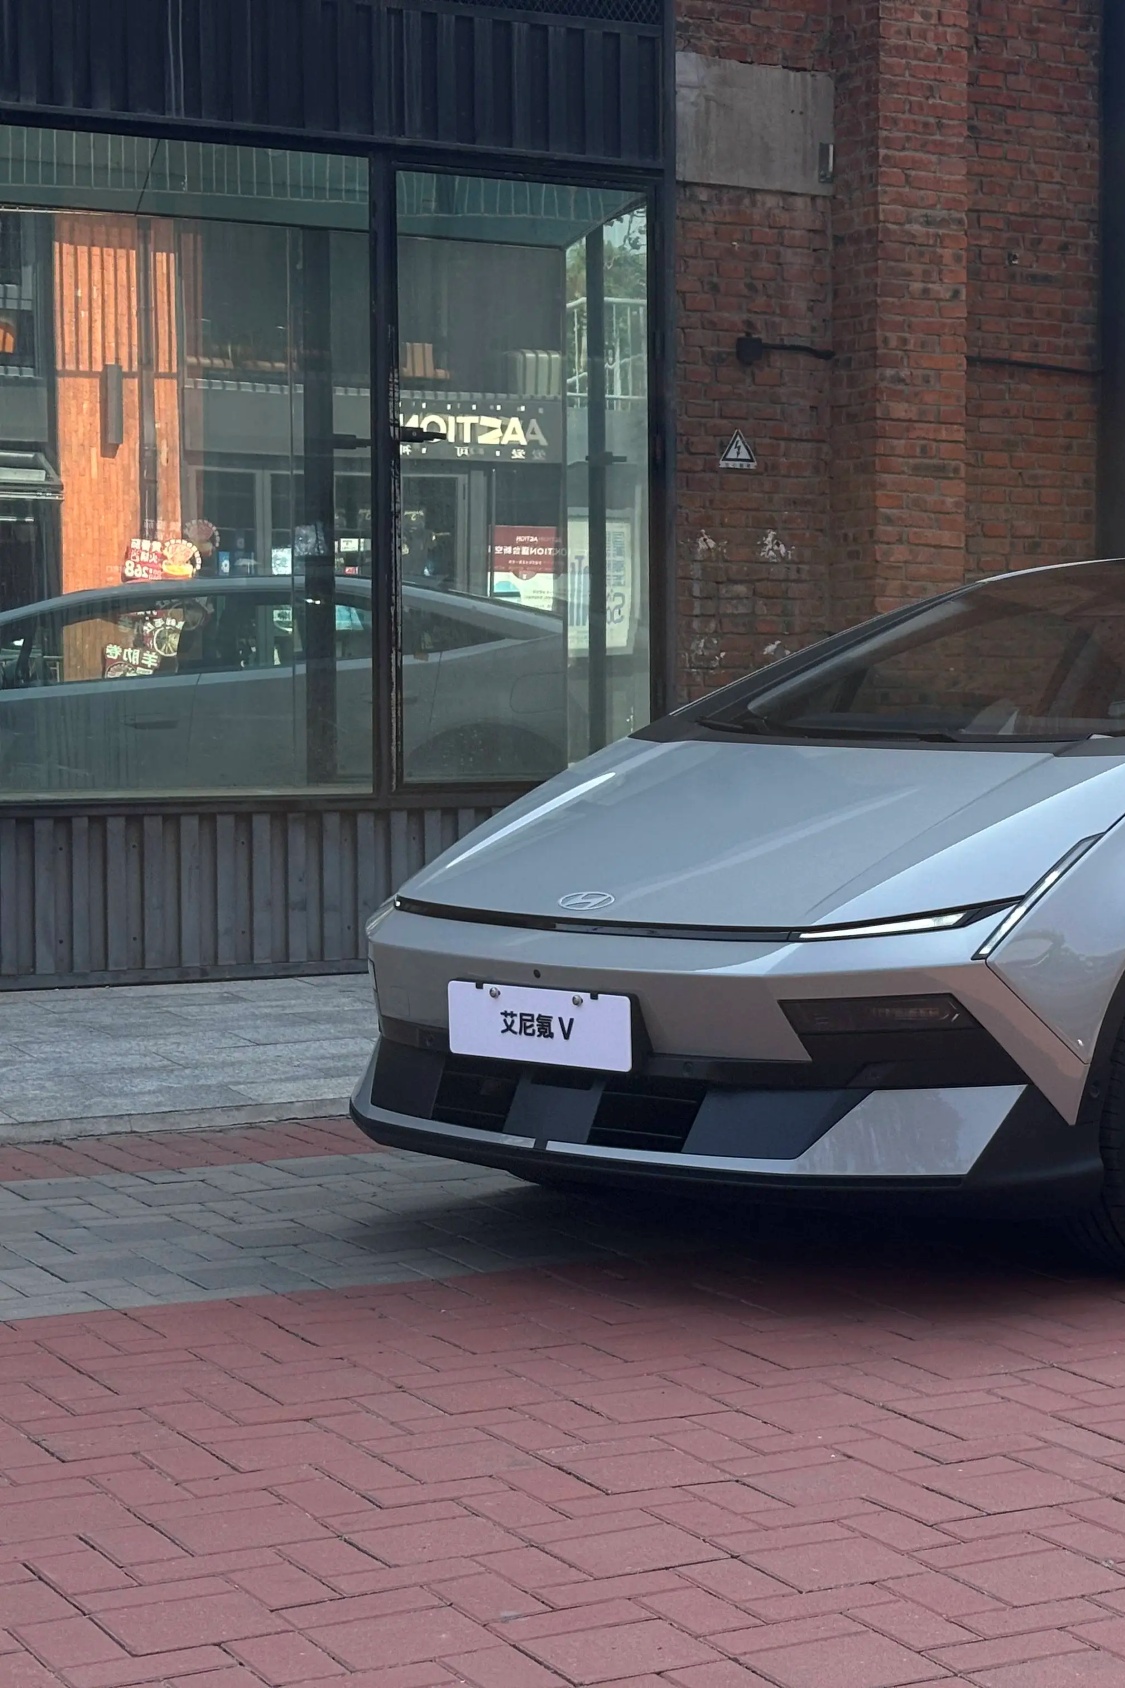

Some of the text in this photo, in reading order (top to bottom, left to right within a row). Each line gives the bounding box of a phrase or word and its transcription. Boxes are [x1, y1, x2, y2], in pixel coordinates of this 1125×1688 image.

[500, 1010, 575, 1040] 艾尼氪 V
